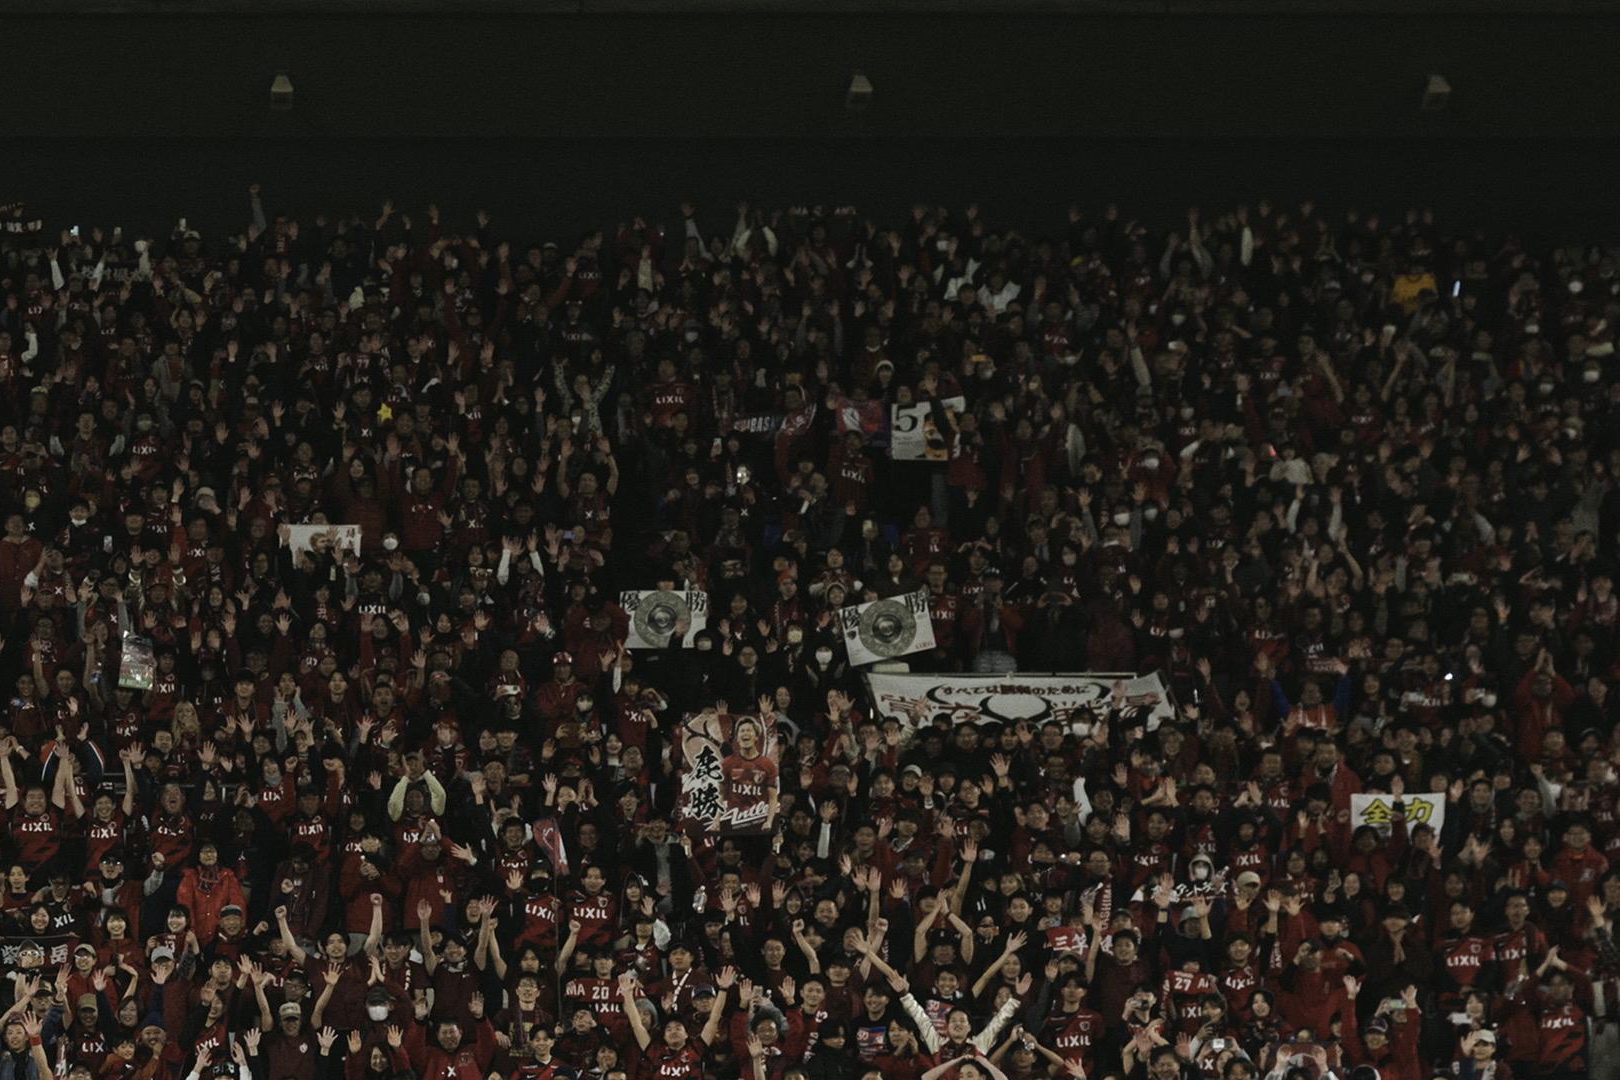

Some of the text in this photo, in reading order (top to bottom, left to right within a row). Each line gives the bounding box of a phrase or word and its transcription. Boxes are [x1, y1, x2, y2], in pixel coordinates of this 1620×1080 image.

[732, 783, 762, 795] LIXIL
[1360, 798, 1436, 825] 全力
[21, 822, 53, 833] LIXIL
[524, 903, 557, 923] LIXIL
[573, 906, 608, 920] LIXIL
[54, 913, 75, 928] XIL
[1446, 955, 1481, 967] LIXIL
[1174, 975, 1194, 991] 27
[592, 986, 610, 1001] 20
[593, 1001, 622, 1014] IXIL
[1542, 1016, 1575, 1030] LIXIL
[1055, 1034, 1092, 1048] LIXIL
